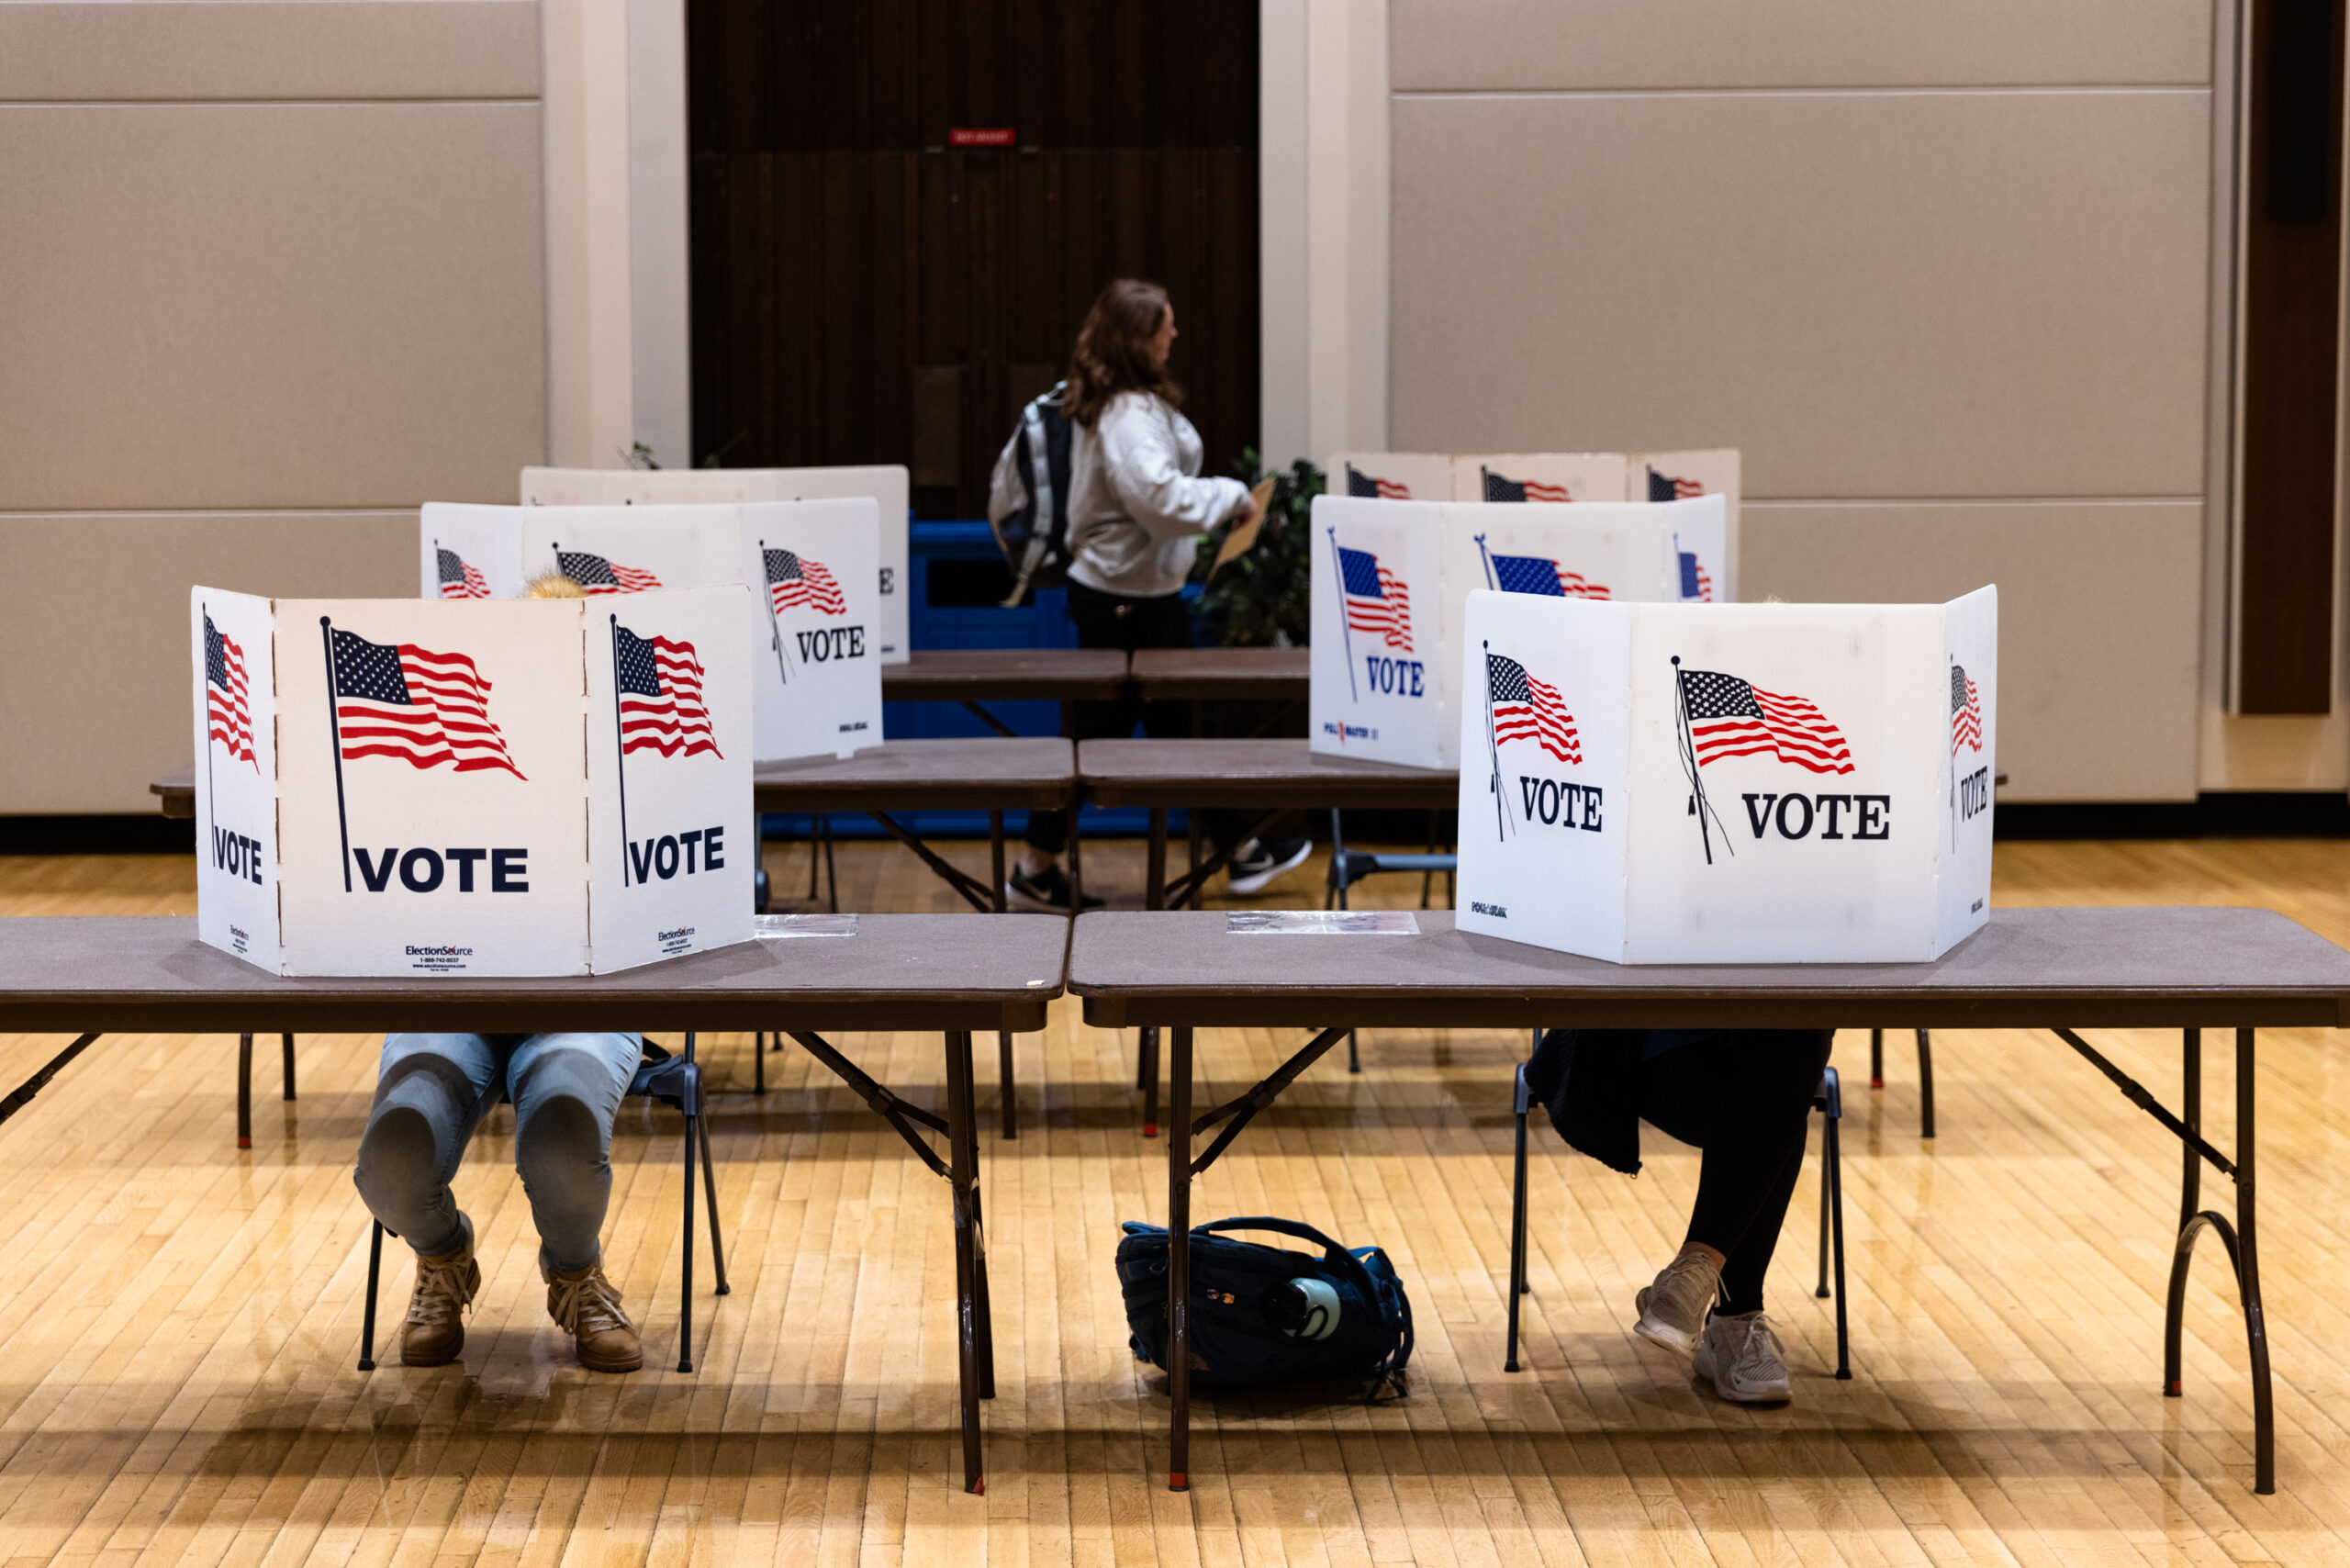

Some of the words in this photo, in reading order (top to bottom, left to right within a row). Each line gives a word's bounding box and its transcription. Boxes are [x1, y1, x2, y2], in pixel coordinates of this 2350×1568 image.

[797, 625, 866, 664] VOTE
[1367, 655, 1425, 698] VOTE
[1520, 776, 1603, 833] VOTE
[1741, 792, 1891, 840] VOTE
[1961, 766, 1987, 823] VOTE
[214, 825, 263, 886] VOTE
[352, 847, 530, 893] VOTE
[629, 826, 724, 885] VOTE
[406, 945, 473, 956] ElectionSource
